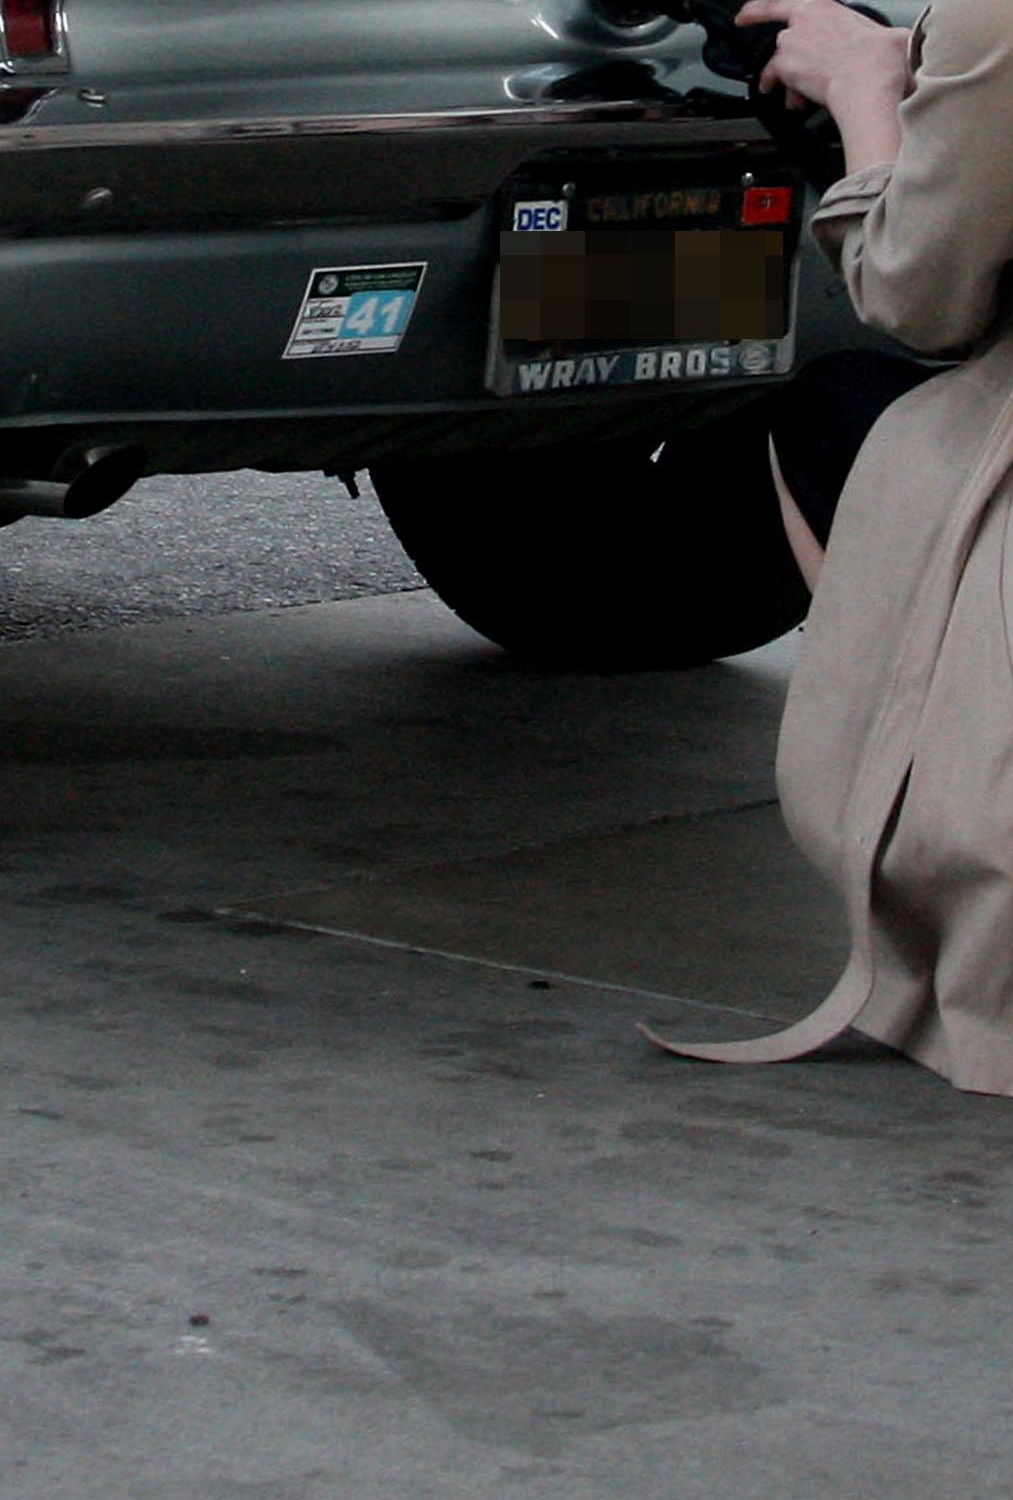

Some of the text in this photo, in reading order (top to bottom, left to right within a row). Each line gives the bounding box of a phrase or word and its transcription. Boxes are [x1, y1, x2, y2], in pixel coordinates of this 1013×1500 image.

[516, 207, 561, 231] DEC
[345, 296, 404, 334] 41
[518, 347, 731, 392] WRAY BROS
